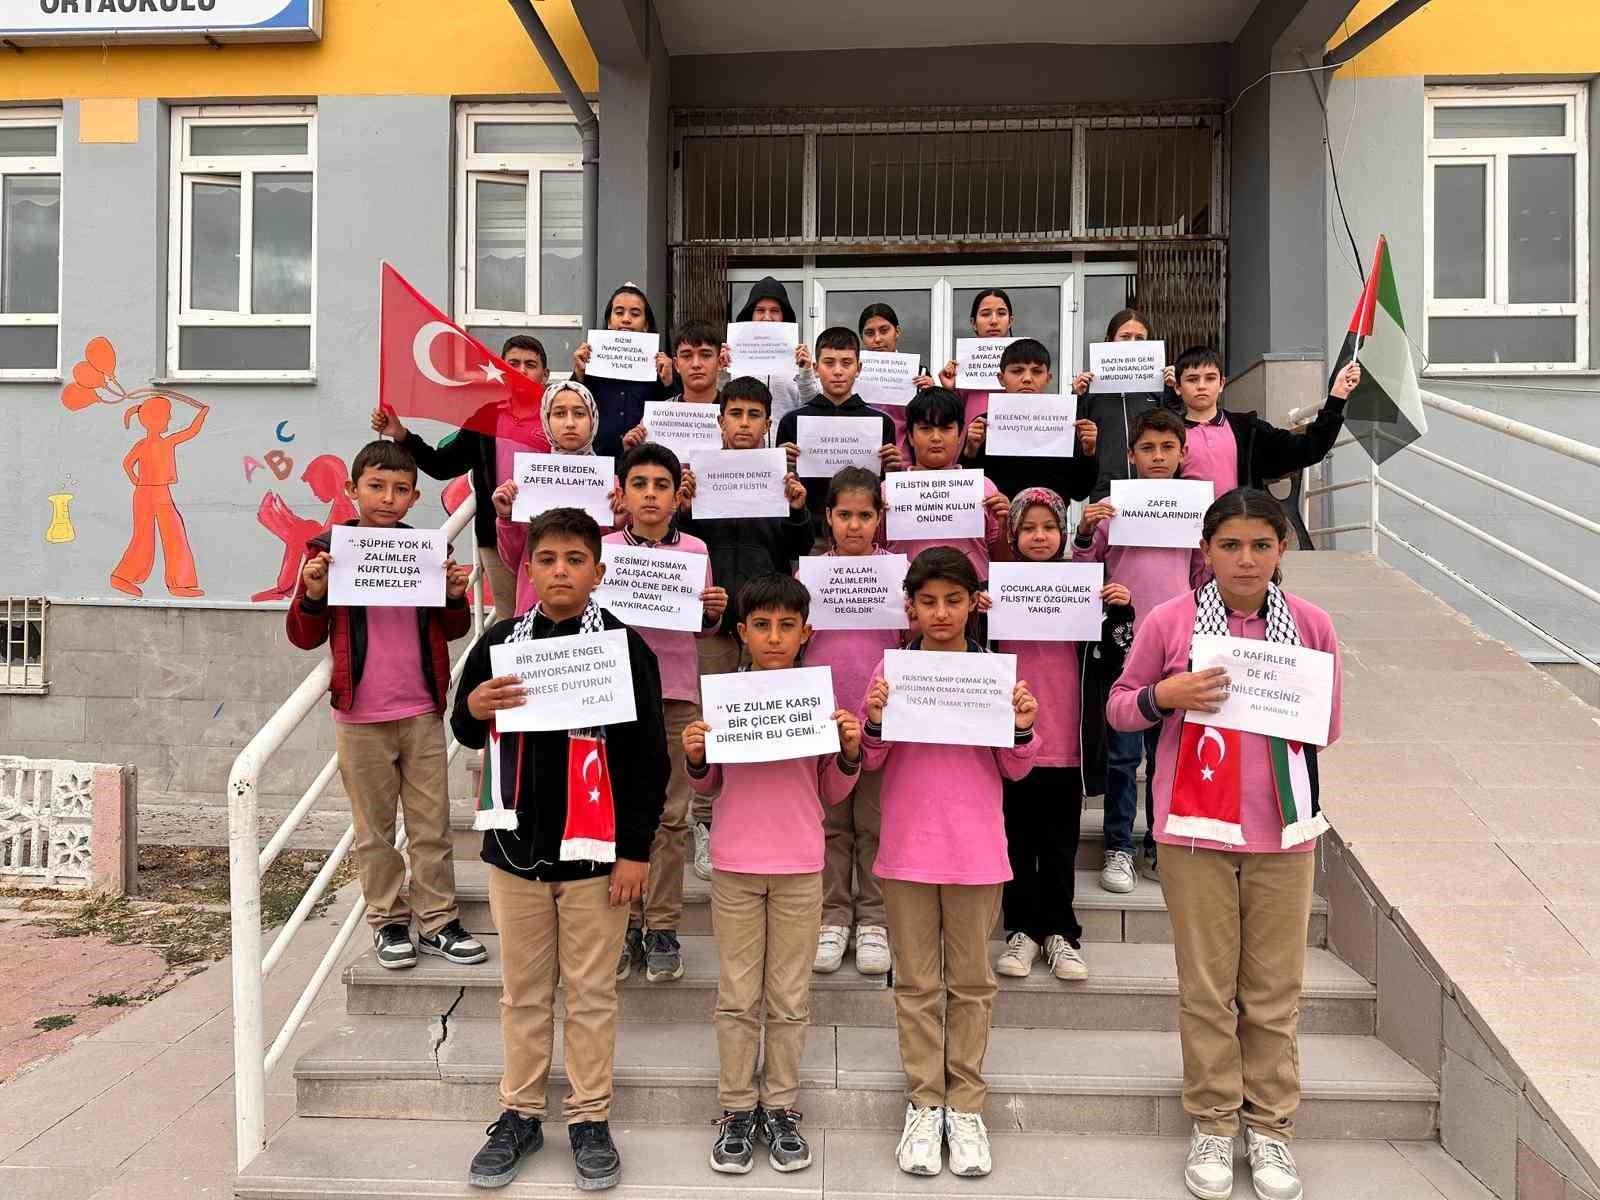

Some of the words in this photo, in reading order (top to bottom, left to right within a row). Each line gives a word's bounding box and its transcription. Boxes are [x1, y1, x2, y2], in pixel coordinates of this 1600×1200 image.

[531, 464, 561, 473] SEFER
[523, 476, 554, 485] ZAFER
[554, 478, 604, 487] ALLAH'TAN
[948, 479, 974, 487] SINAV
[894, 504, 913, 513] HER
[914, 503, 943, 512] MÜMİN
[945, 502, 976, 511] KULUN
[1147, 499, 1177, 508] ZAFER
[398, 540, 420, 550] YOK
[364, 551, 417, 563] ZALİMLER
[357, 564, 421, 576] KURTULUŞA
[651, 560, 688, 571] KISMAYA
[661, 583, 679, 593] DEK
[680, 585, 693, 594] BU
[820, 586, 888, 595] YAPTIKLARINDAN
[1000, 584, 1054, 594] ÇOCUKLARA
[1055, 584, 1092, 593] GÜLMEK
[823, 597, 844, 605] ASLA
[515, 652, 533, 666] BİR
[535, 649, 571, 663] ZULME
[572, 645, 605, 657] ENGEL
[1232, 648, 1241, 657] O
[1243, 650, 1297, 668] KAFİRLERE
[510, 663, 591, 680] AMIYORSANIZ
[593, 659, 617, 671] ONU
[1247, 668, 1261, 680] DE
[561, 676, 613, 692] DUYURUN
[725, 703, 741, 714] VE
[743, 699, 783, 713] ZULME
[785, 696, 821, 709] KARŞI
[906, 694, 937, 707] İNSAN
[728, 715, 748, 729] BİR
[789, 709, 813, 723] GİBİ
[716, 730, 763, 743] DİRENİR
[766, 729, 783, 740] BU
